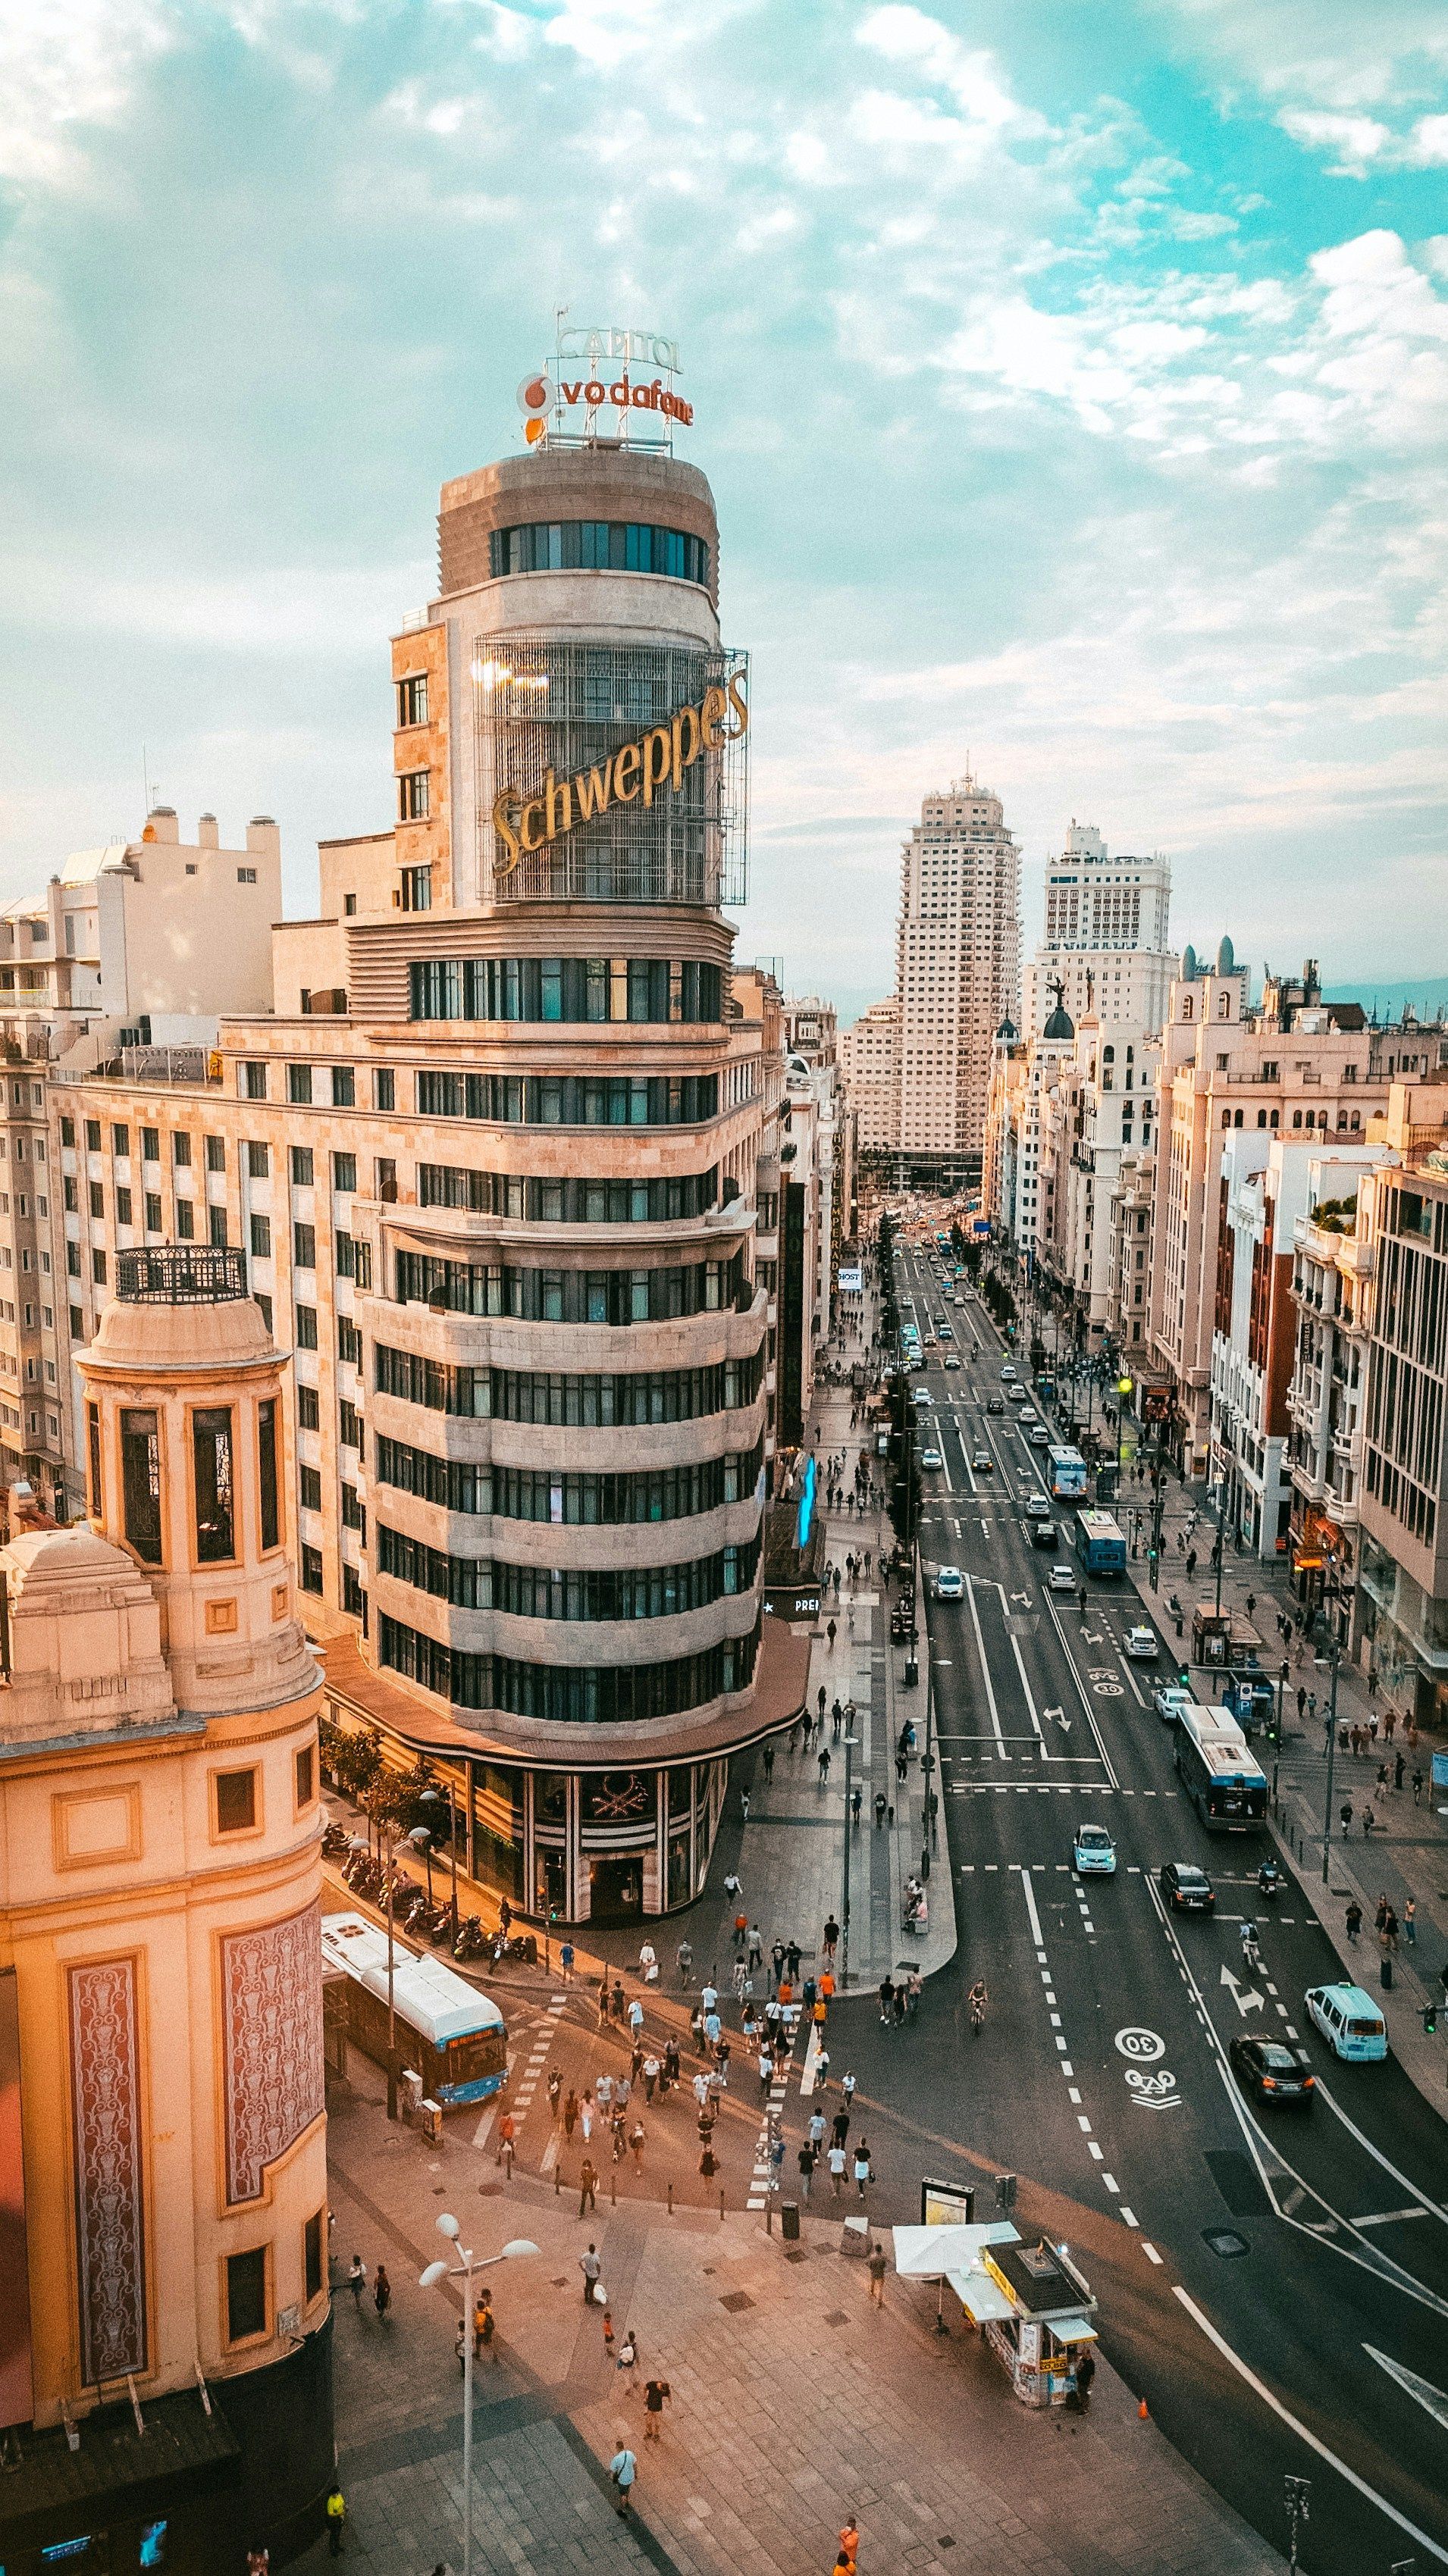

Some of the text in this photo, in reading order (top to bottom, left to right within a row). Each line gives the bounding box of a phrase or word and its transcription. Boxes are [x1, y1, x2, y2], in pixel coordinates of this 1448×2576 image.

[556, 326, 683, 374] CAPITOL
[561, 374, 694, 426] vodafone
[493, 669, 748, 878] Schweppes
[1126, 2036, 1153, 2053] 30
